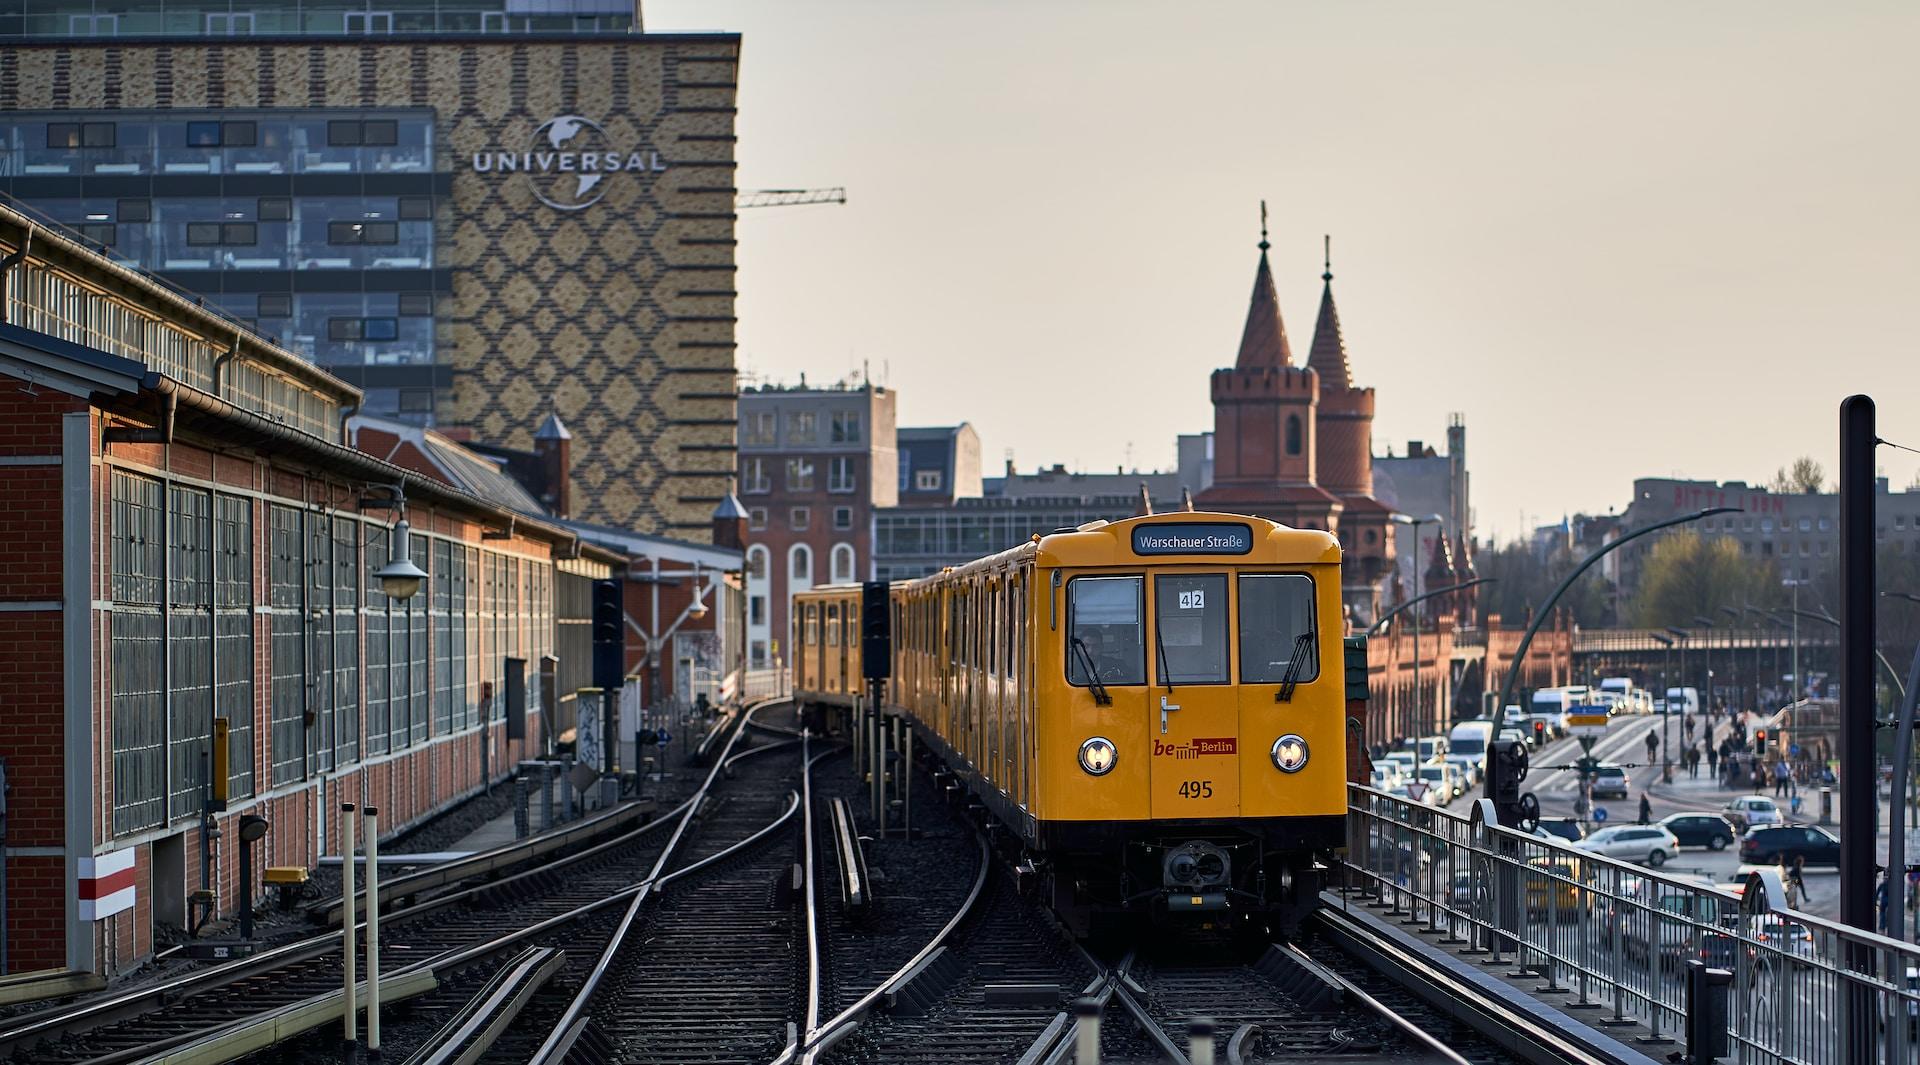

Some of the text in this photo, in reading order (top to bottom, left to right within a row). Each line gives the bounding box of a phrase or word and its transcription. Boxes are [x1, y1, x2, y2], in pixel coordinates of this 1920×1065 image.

[473, 153, 667, 171] UNIVERSAL
[1140, 535, 1243, 548] Warschauer Straße
[1181, 594, 1202, 607] 42
[1153, 739, 1233, 756] be Berlin
[1178, 780, 1213, 799] 495
